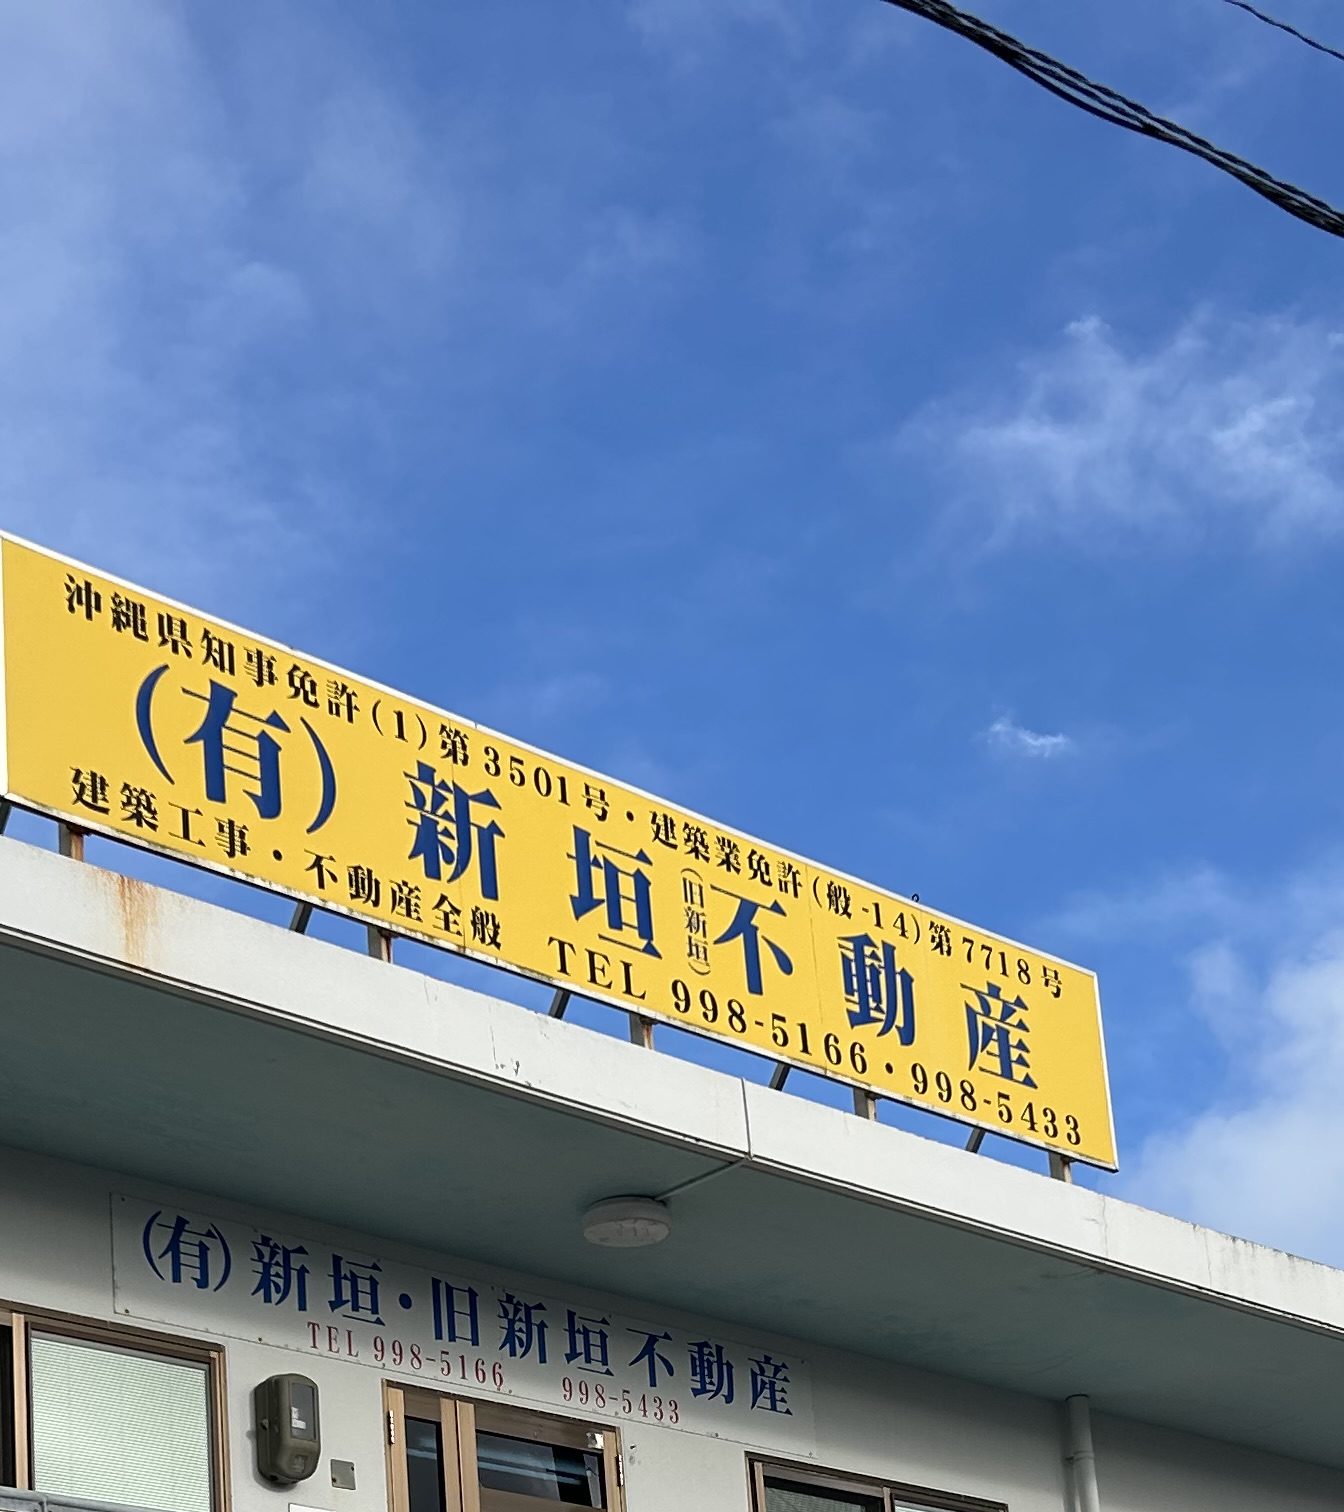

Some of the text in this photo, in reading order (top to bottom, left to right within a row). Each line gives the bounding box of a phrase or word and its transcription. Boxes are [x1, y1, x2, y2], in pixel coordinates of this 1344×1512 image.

[69, 765, 502, 951] 建築工事・不動産全般
[547, 936, 646, 1000] TEL
[307, 1320, 681, 1426] TEL 998-5166 998-5433
